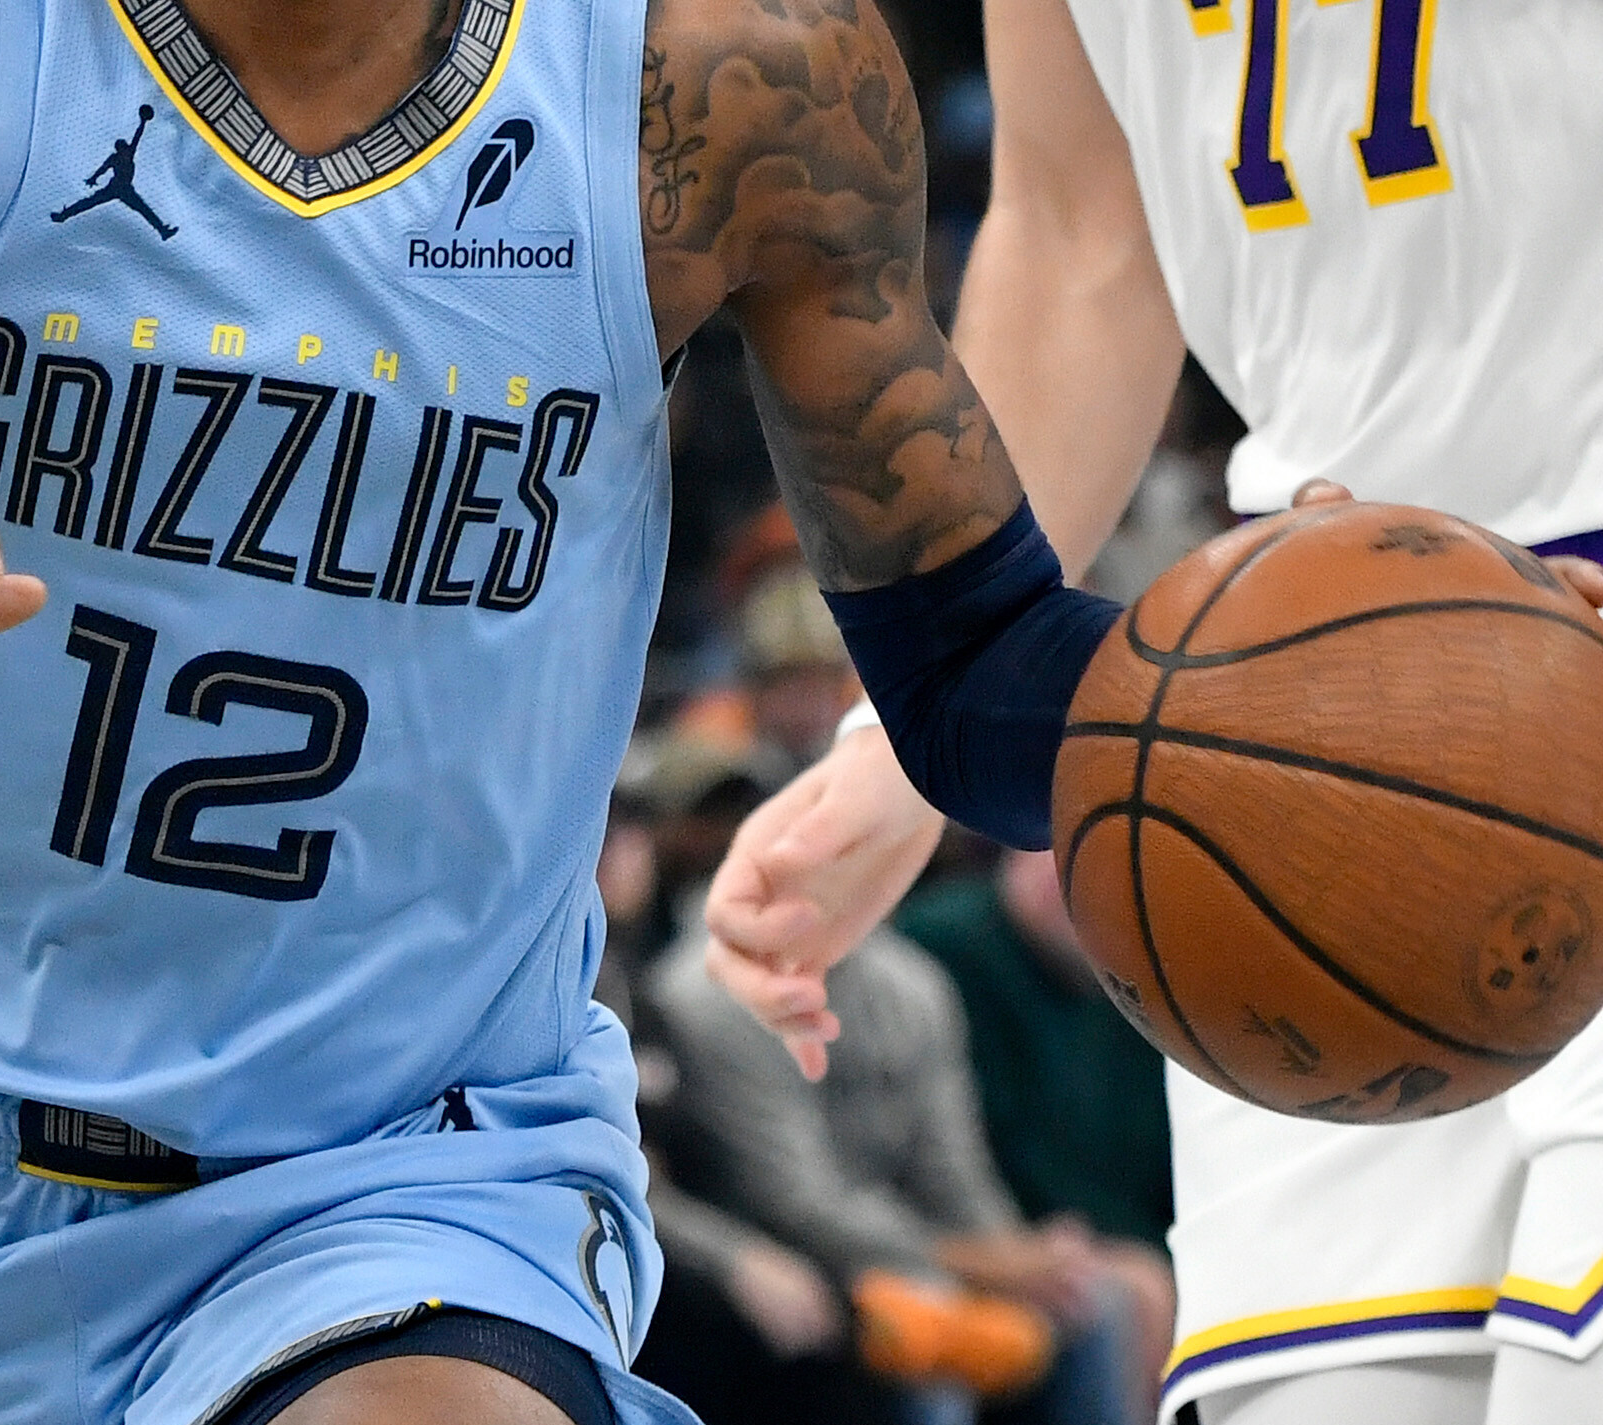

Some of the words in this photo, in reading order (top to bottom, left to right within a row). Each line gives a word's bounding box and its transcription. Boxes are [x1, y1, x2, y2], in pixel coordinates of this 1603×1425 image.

[409, 238, 575, 269] Robinhood
[42, 312, 530, 409] MEMPHIS
[48, 602, 370, 903] 12
